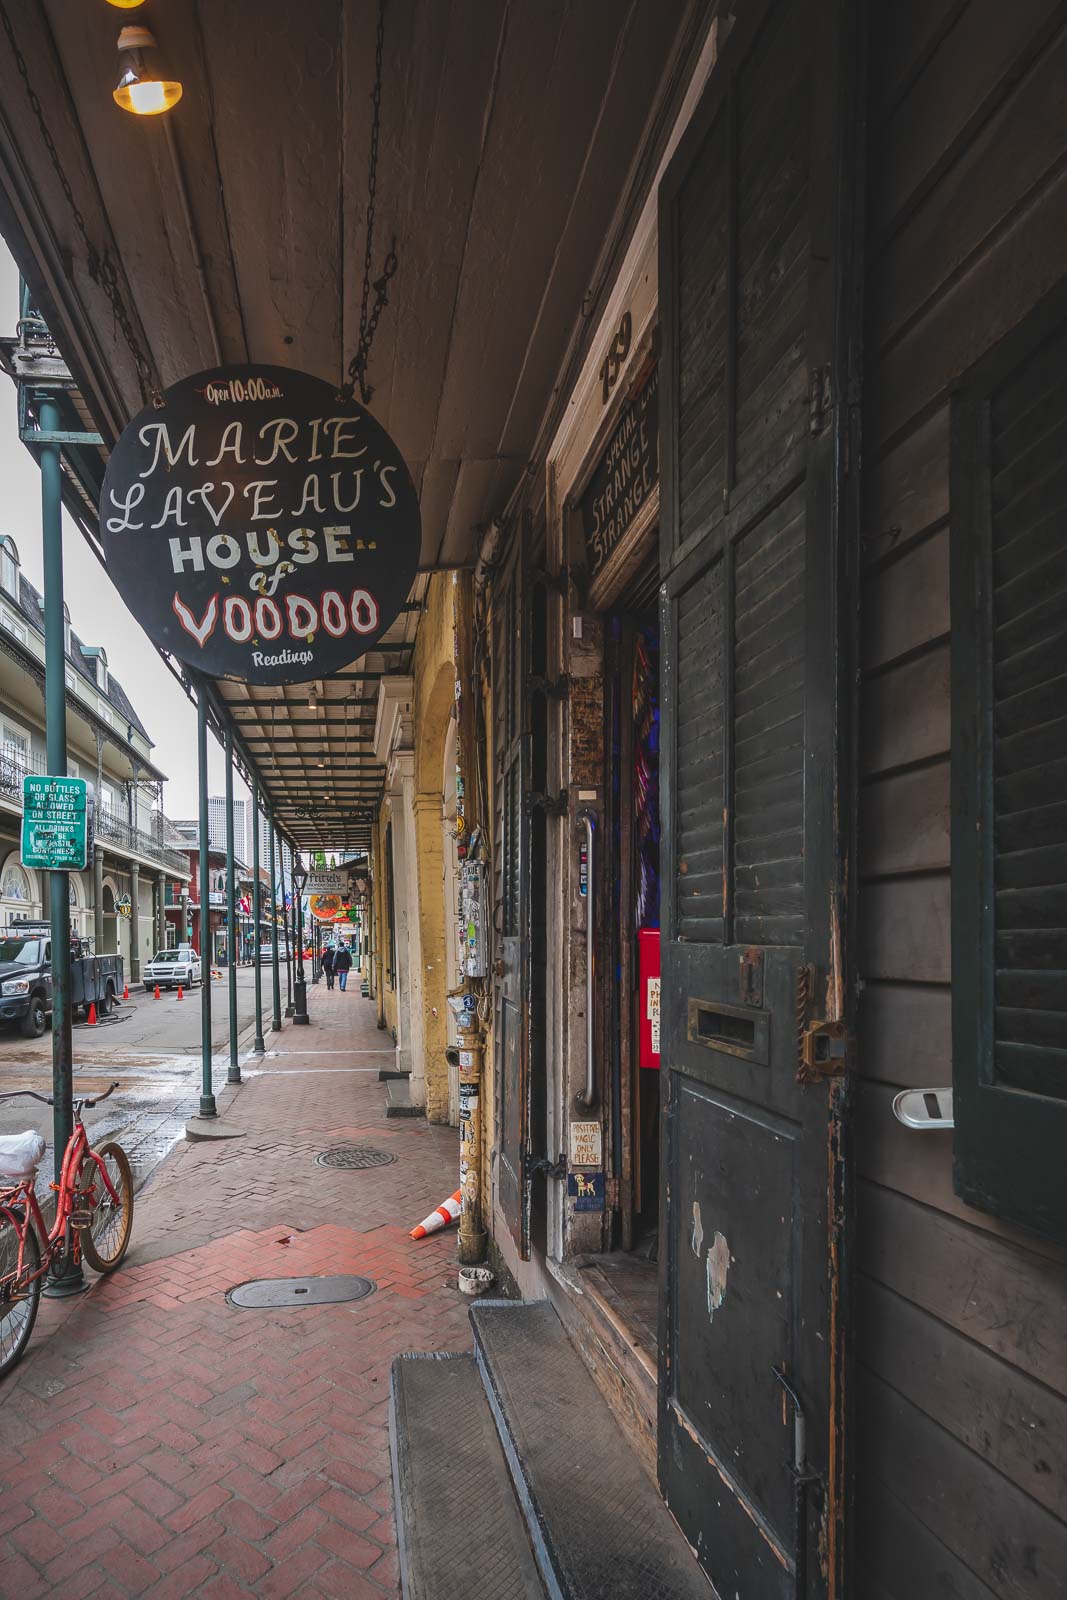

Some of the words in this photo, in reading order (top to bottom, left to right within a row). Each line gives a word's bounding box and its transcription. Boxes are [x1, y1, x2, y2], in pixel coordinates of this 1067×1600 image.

[138, 416, 368, 478] MARIE
[592, 417, 649, 538] STRANGE
[106, 459, 398, 533] LAVEAU'S
[593, 455, 652, 567] STRANGE
[168, 525, 354, 574] HOUSE
[249, 560, 298, 596] of
[172, 587, 381, 648] VOODOO
[251, 648, 314, 667] Readings
[30, 784, 41, 792] NO
[44, 784, 80, 794] BOTTLES
[34, 793, 46, 801] OR
[48, 794, 76, 803] GLASS
[36, 802, 74, 811] ALLOWED
[32, 810, 43, 819] ON
[46, 812, 77, 820] STREET
[48, 825, 74, 833] DRINKS
[572, 1124, 600, 1134] POSITIVE
[576, 1144, 594, 1153] ONLY
[574, 1153, 599, 1163] PLEASE
